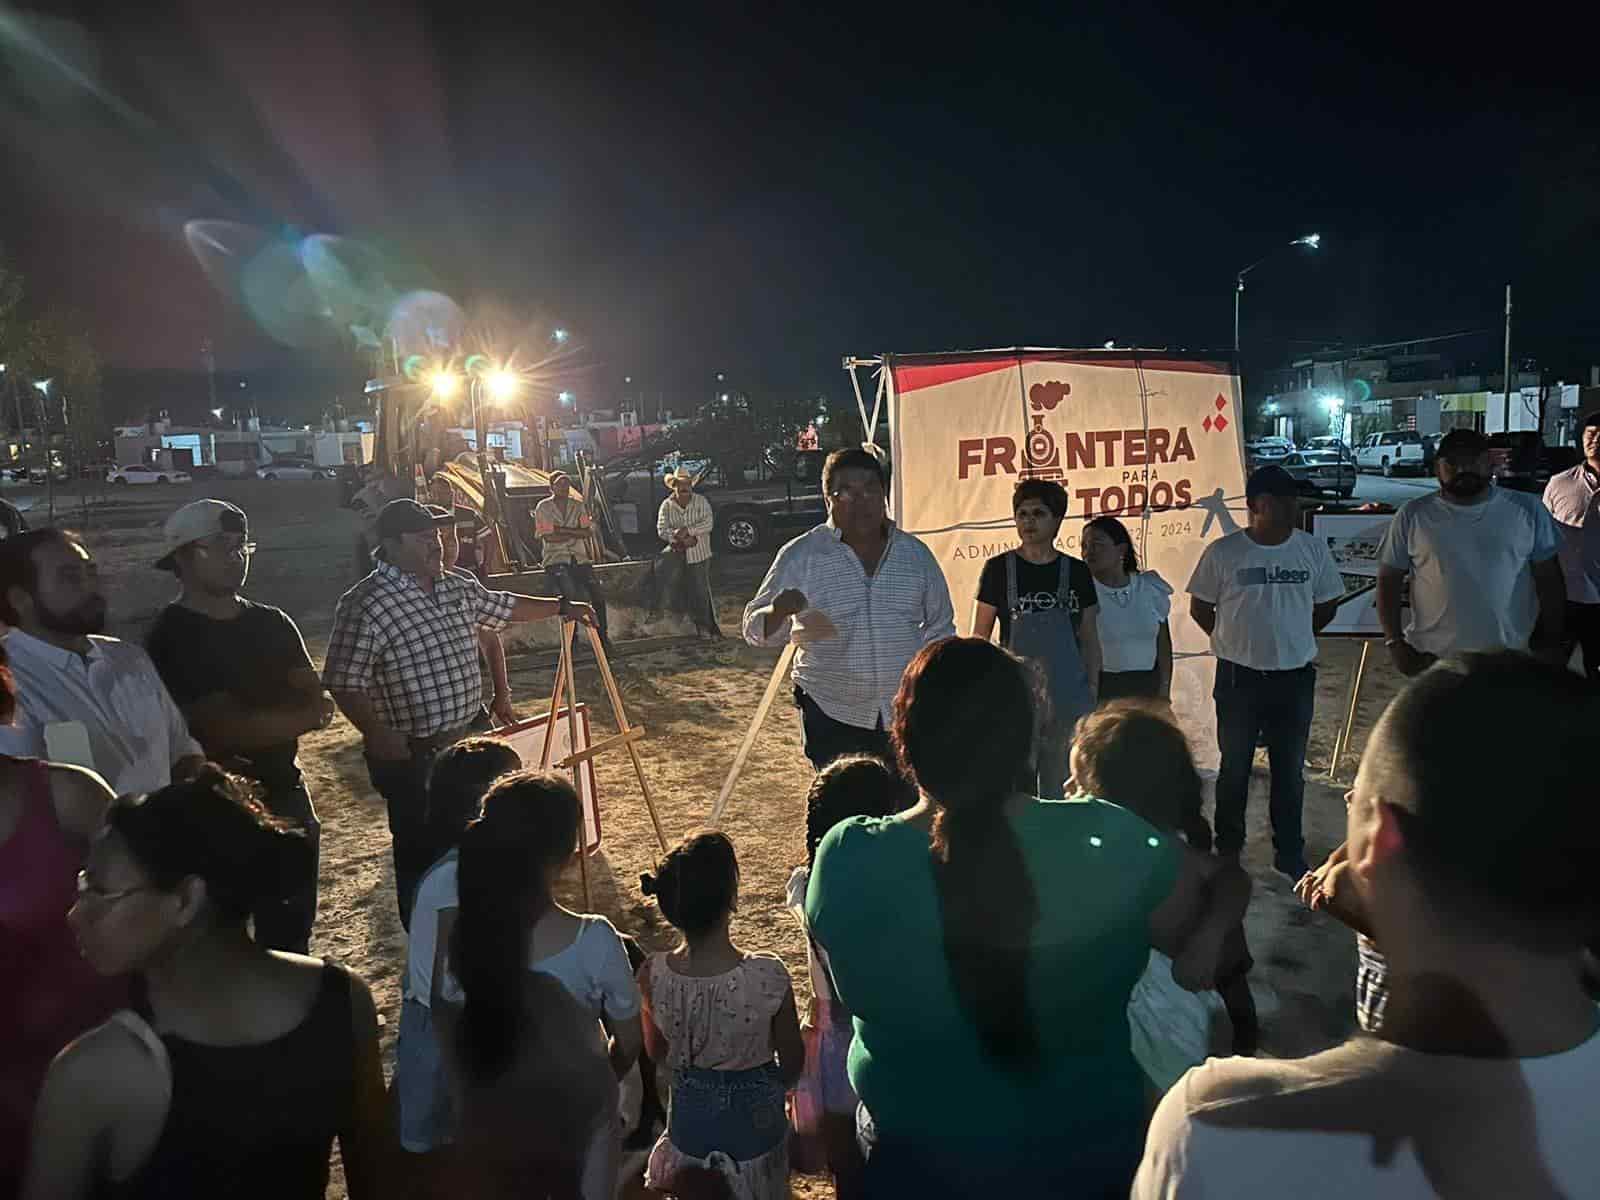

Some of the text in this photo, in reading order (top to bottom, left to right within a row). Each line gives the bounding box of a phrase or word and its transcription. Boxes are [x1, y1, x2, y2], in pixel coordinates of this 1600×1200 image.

[1122, 469, 1158, 484] PARA
[1075, 479, 1192, 521] TODOS
[1160, 521, 1192, 538] 2024
[1268, 566, 1310, 583] Jeep
